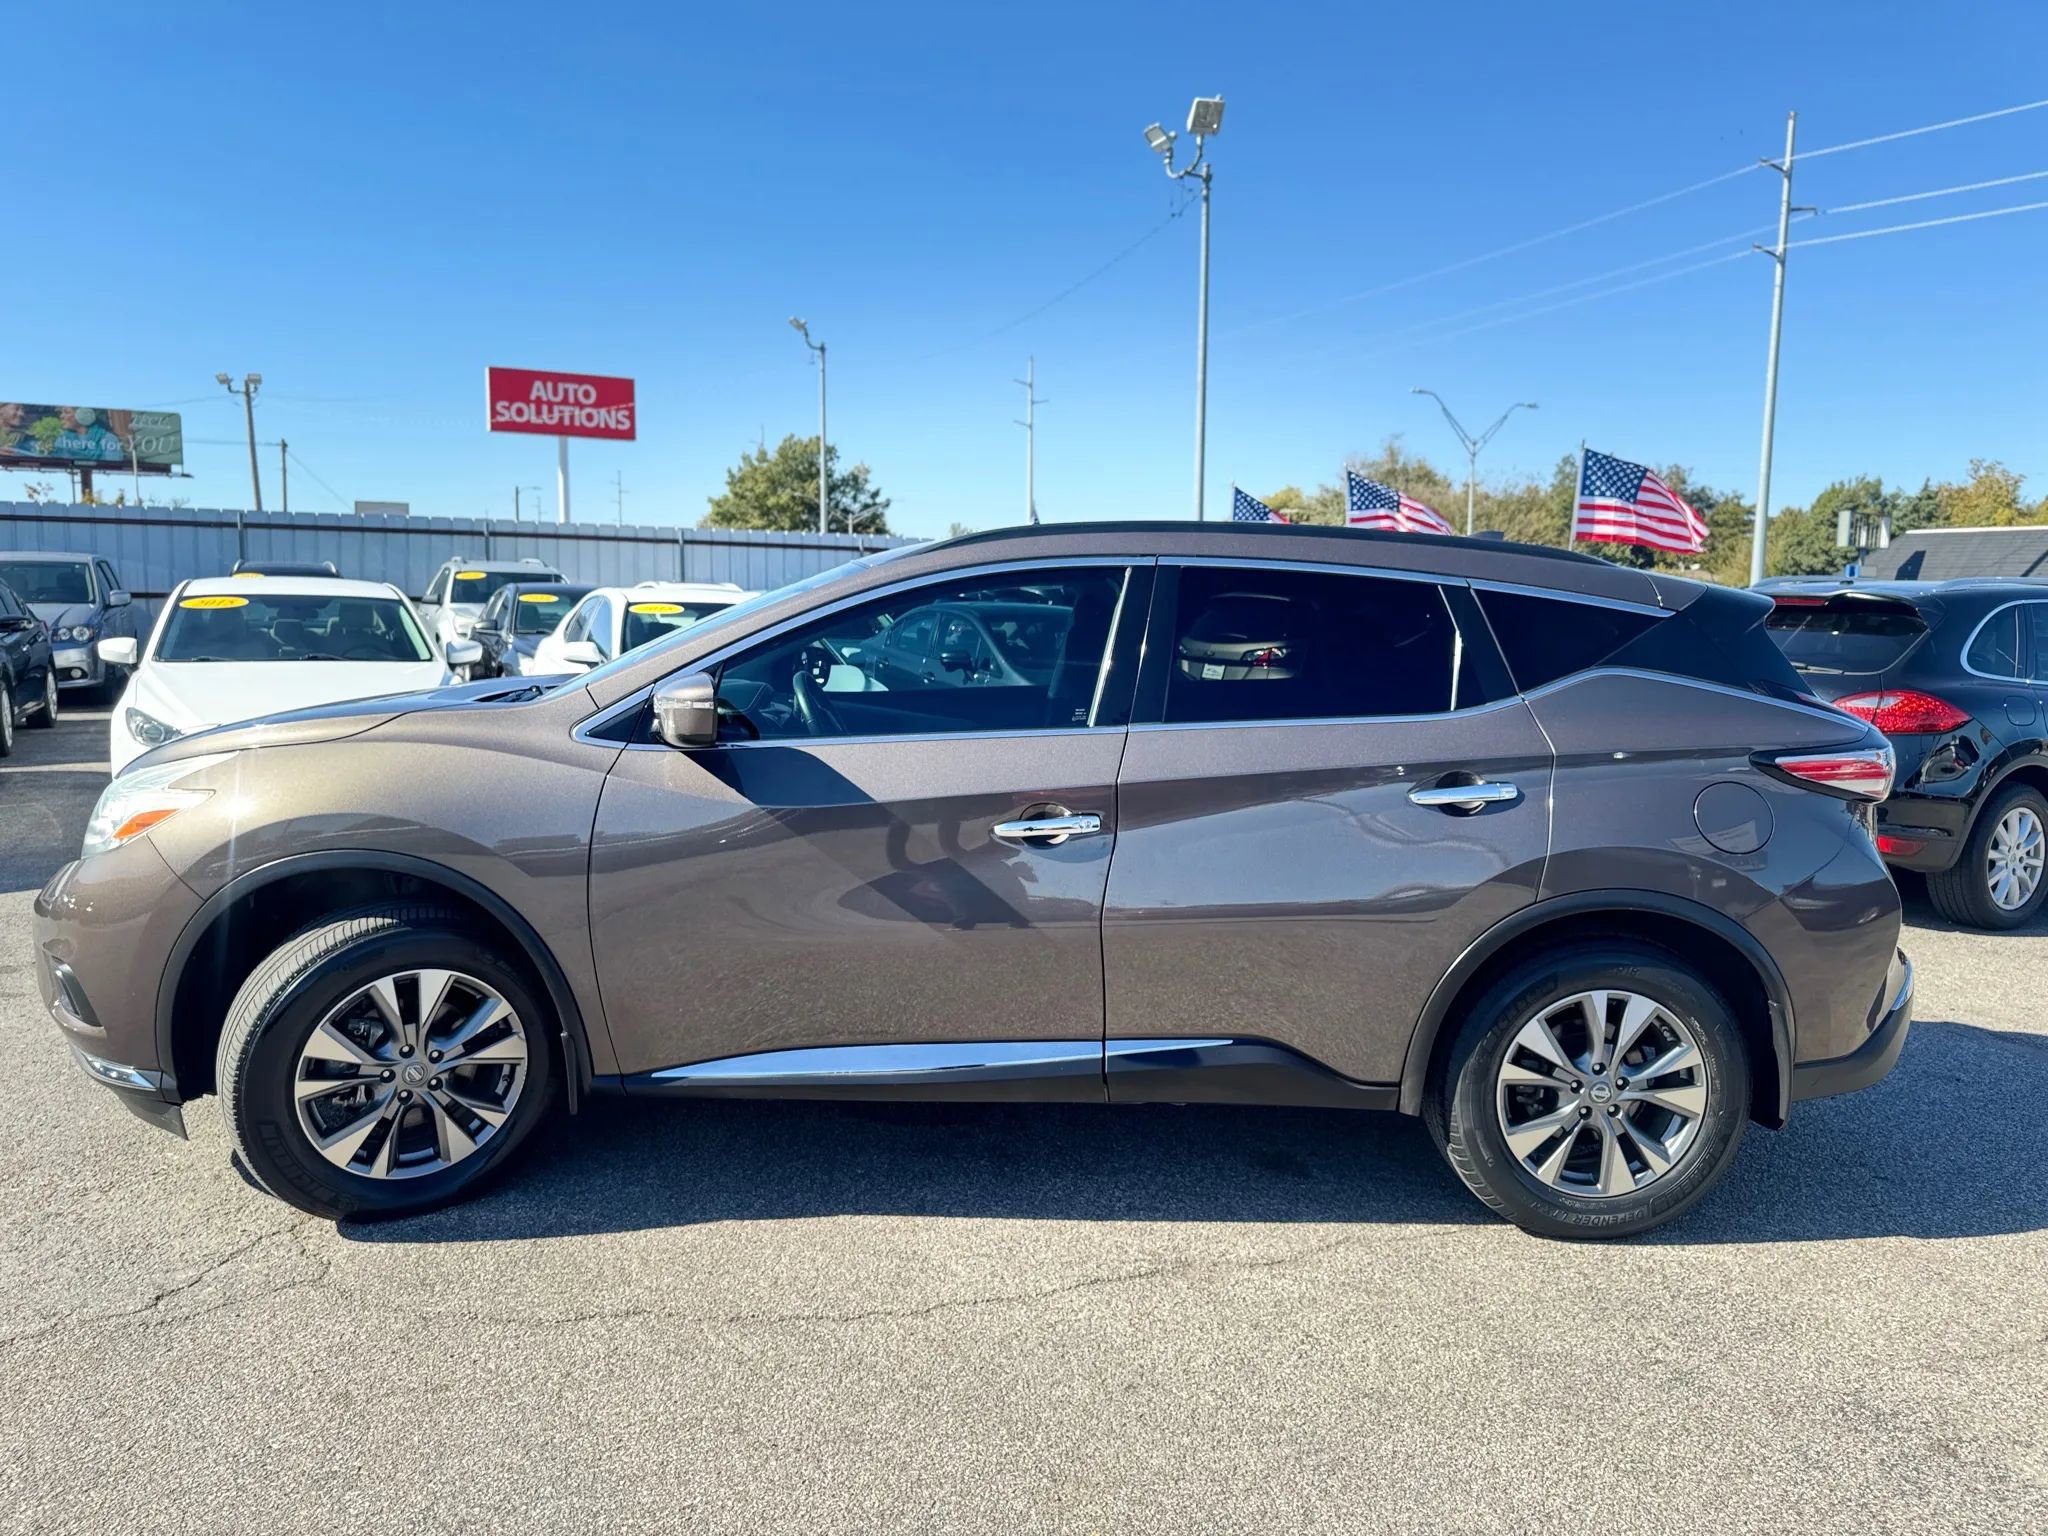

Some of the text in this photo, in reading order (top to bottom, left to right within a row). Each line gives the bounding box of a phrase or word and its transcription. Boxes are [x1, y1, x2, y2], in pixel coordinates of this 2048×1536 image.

[530, 380, 597, 405] AUTO
[495, 400, 631, 430] SOLUTIONS
[62, 433, 177, 454] here for YOU
[1572, 1208, 1646, 1226] DEFENDER
